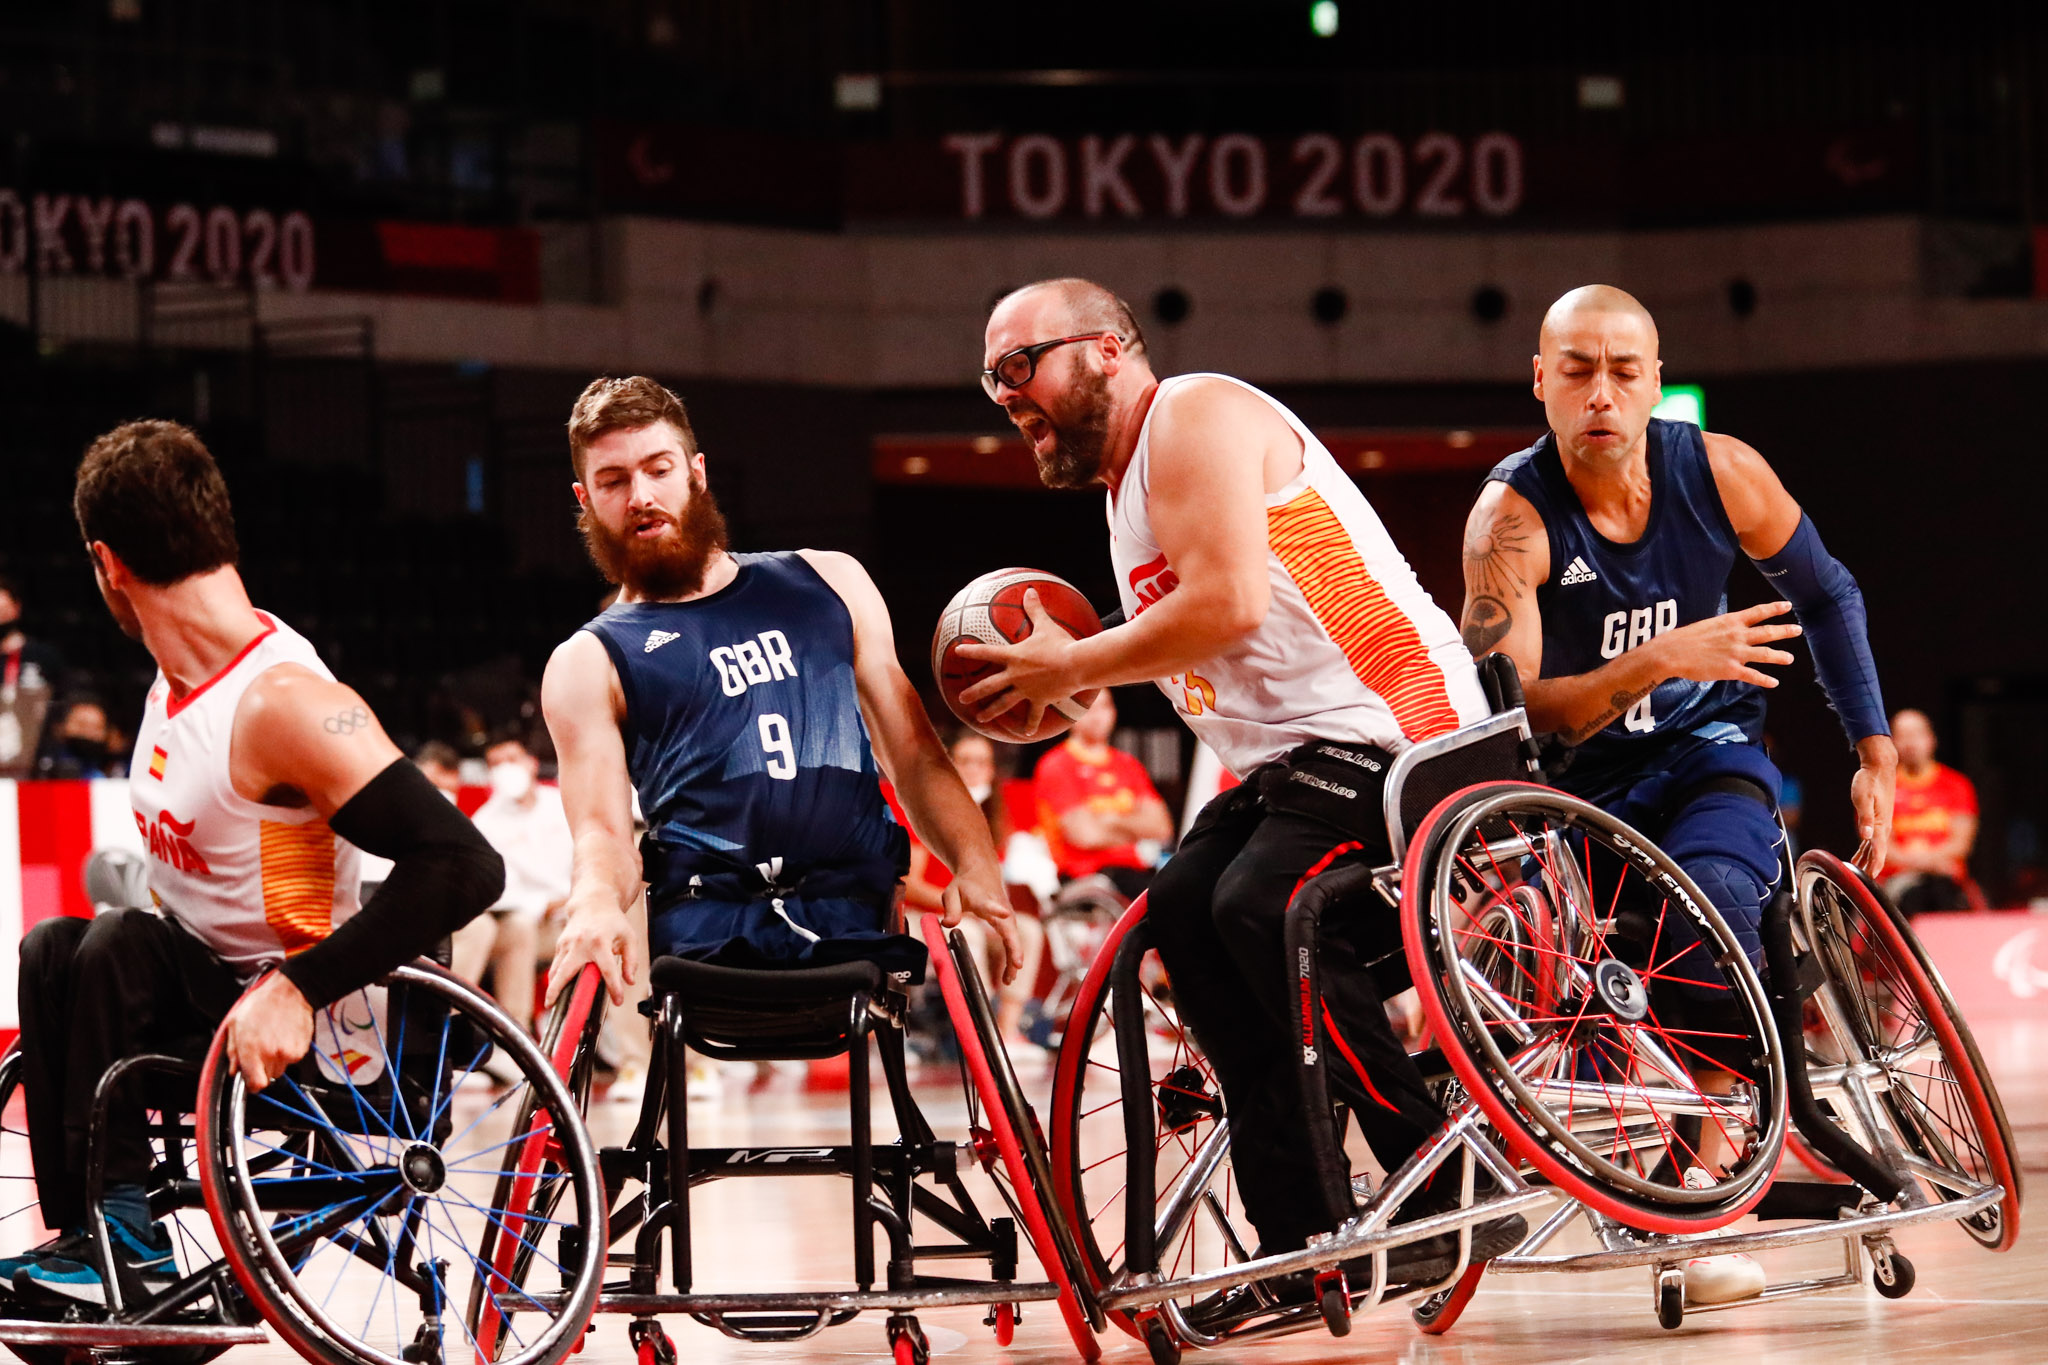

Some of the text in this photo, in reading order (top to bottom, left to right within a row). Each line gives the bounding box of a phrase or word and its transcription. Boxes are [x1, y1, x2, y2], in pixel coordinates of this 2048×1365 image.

[944, 132, 1526, 219] TOKYO 2020
[166, 203, 315, 291] 2020
[1561, 570, 1597, 586] adidas
[644, 631, 681, 653] adidas
[709, 629, 798, 697] GBR
[757, 713, 797, 780] 9
[1624, 693, 1657, 734] 4
